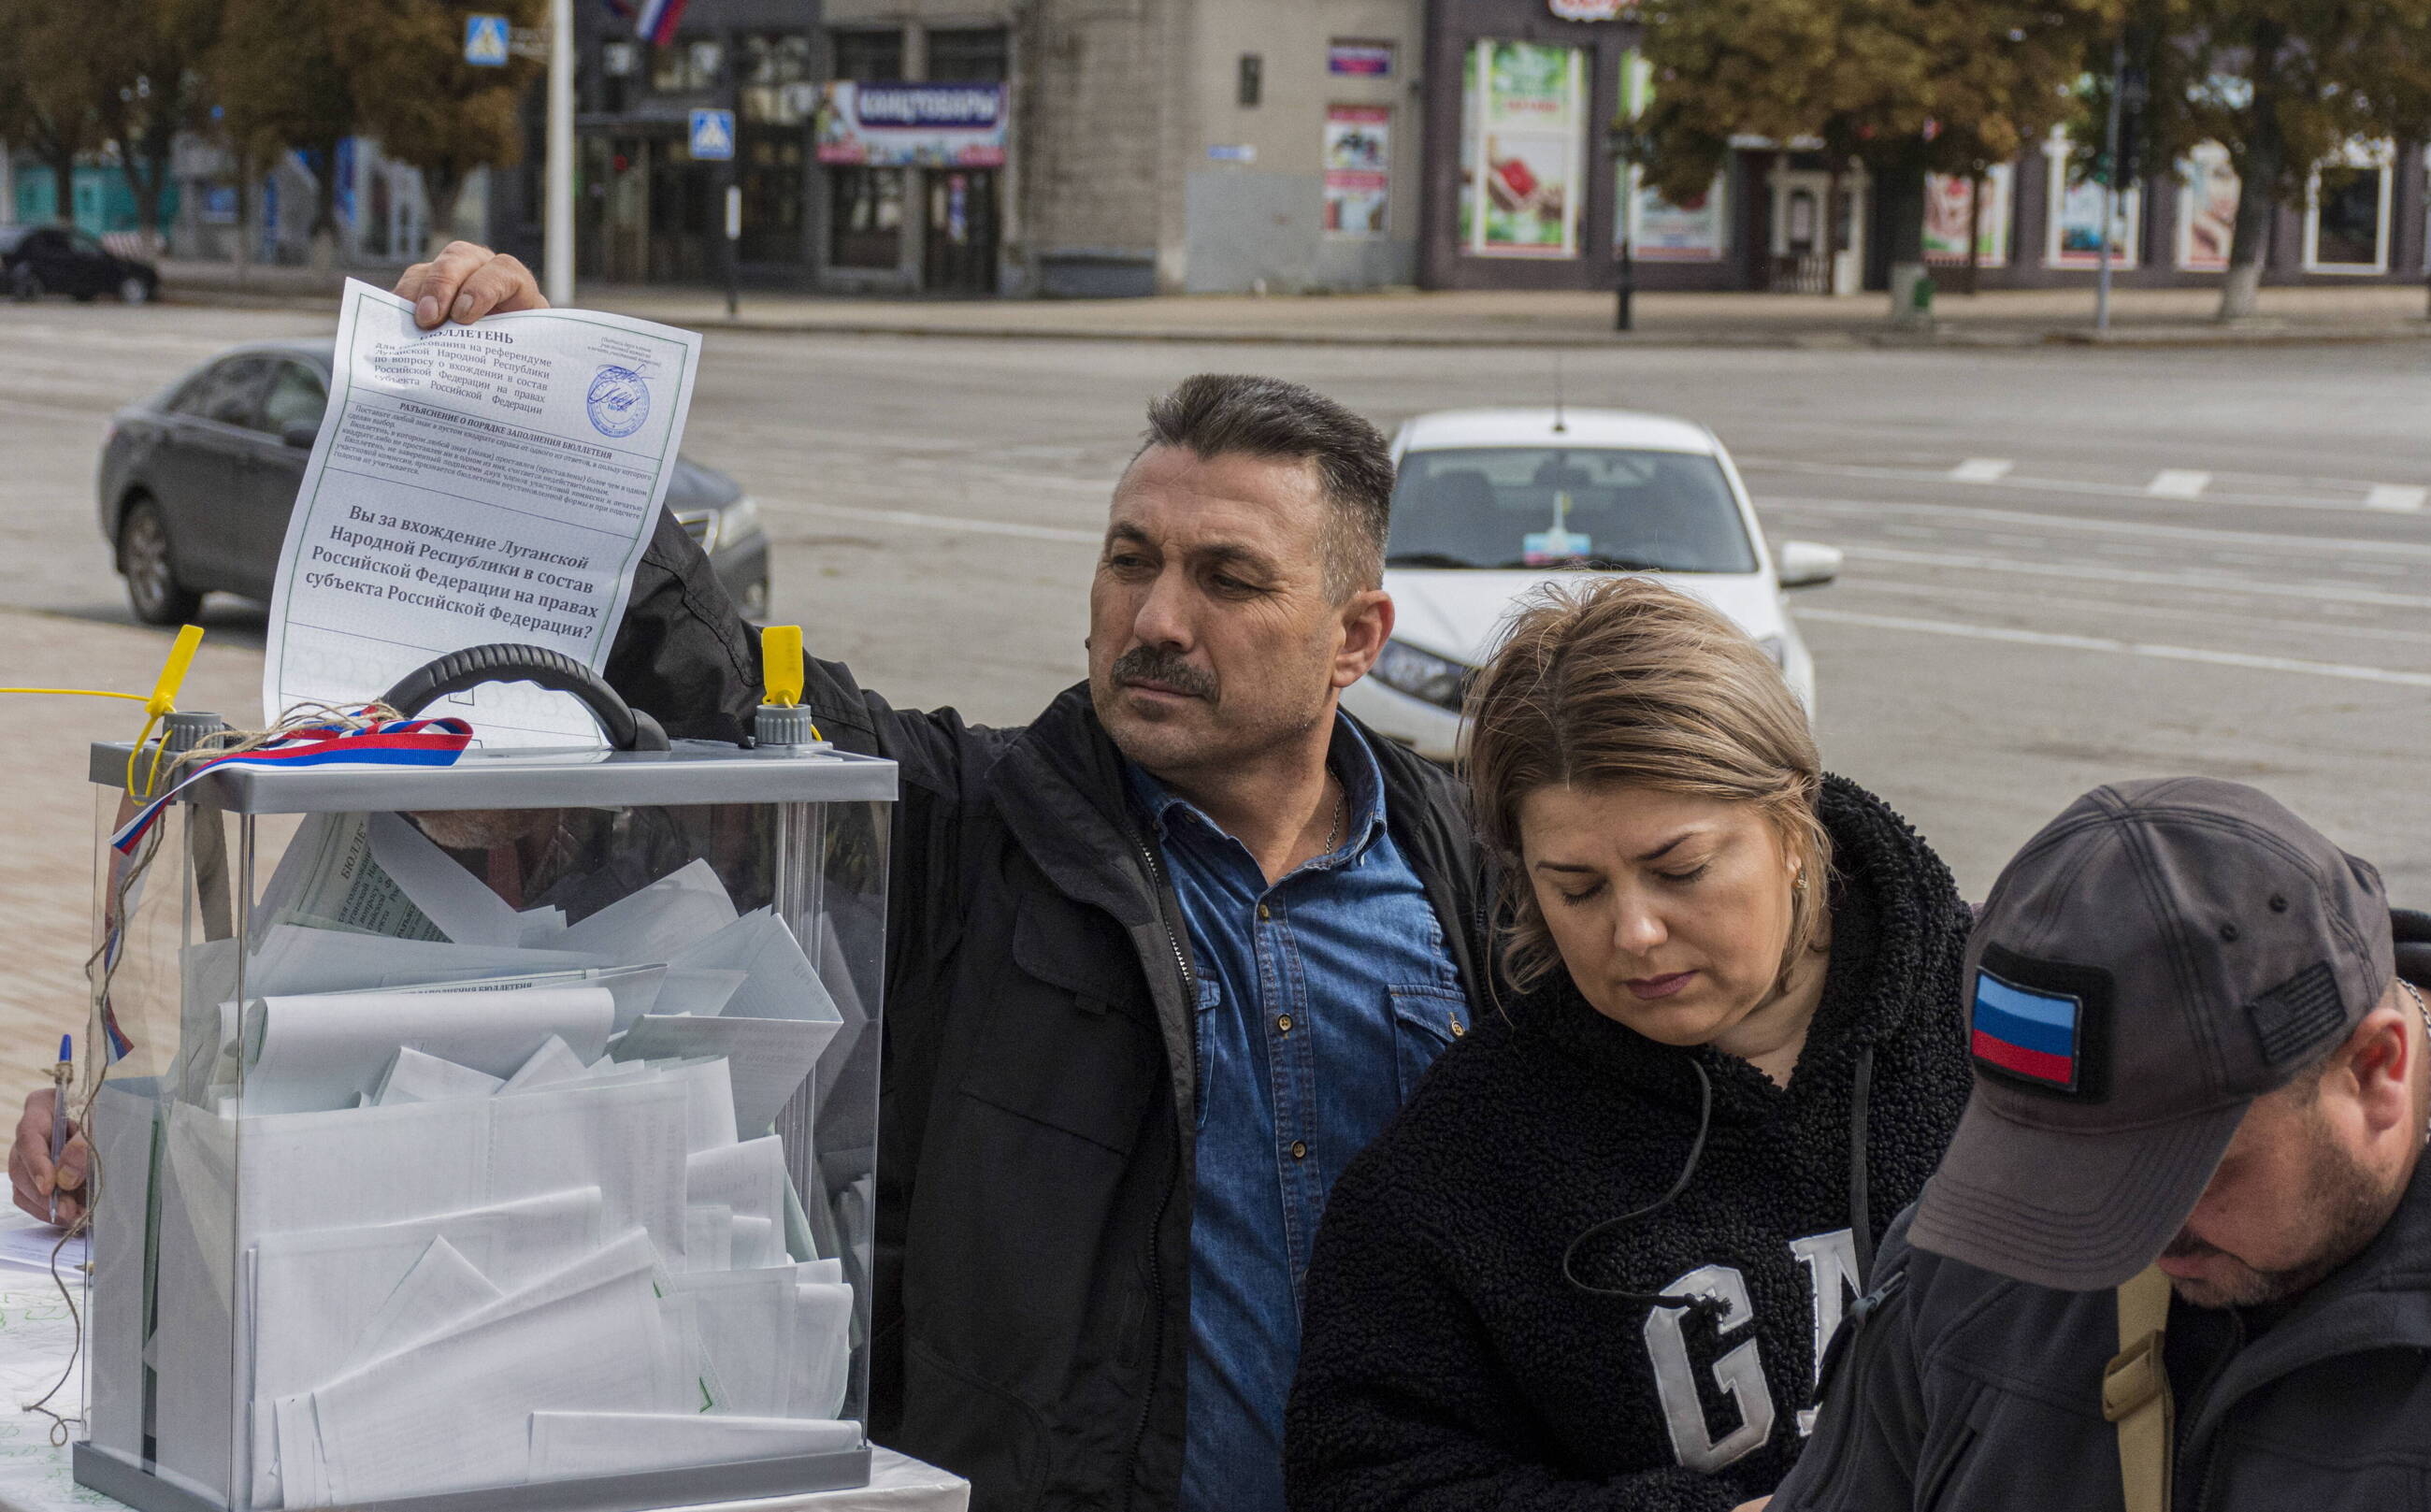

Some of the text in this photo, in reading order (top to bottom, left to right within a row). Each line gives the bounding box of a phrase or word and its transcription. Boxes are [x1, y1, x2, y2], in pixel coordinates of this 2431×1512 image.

[392, 357, 434, 367] вопросу
[449, 363, 503, 381] вхождении
[516, 376, 548, 391] состав
[438, 349, 486, 365] Народной
[494, 358, 550, 380] Республики
[469, 342, 482, 352] на
[485, 346, 552, 367] референдуме
[374, 366, 545, 403] Российской Федерации на правах
[430, 381, 482, 400] Российской
[492, 395, 542, 415] Федерации
[399, 402, 459, 424] РАЗЪЯСНЕНИЕ
[468, 419, 506, 435] ПОРЯДКЕ
[507, 429, 562, 448] ЗАПОЛНЕНИЯ
[563, 441, 612, 460] БЮЛЛЕТЕНЯ
[329, 526, 594, 594] Народной Республики в состав
[349, 505, 589, 569] Вы за вхождение Луганской
[306, 571, 593, 639] субъекта Российской Федерации?
[312, 545, 599, 618] Российской Федерации на правах
